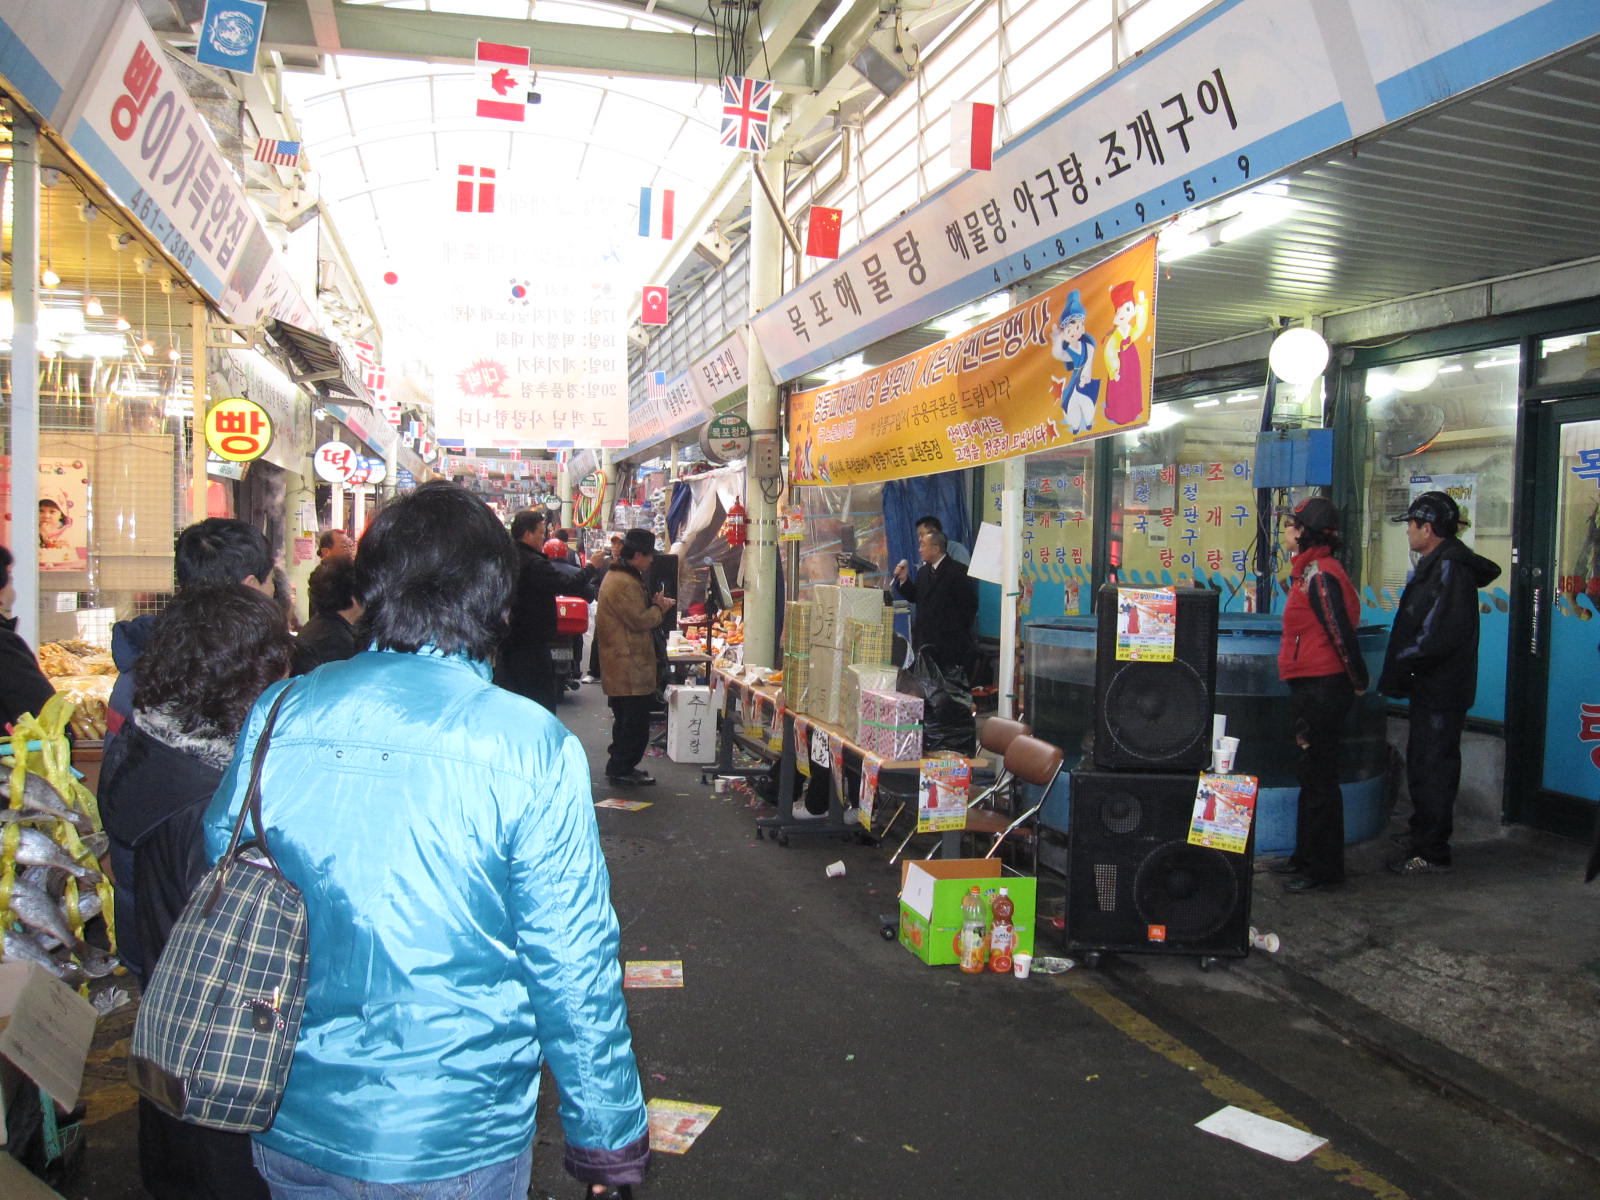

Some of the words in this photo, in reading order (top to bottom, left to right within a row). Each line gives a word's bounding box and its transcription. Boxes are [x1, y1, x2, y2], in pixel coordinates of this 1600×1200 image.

[109, 39, 249, 271] 빵이가득한집
[130, 187, 197, 269] 461-7386
[786, 229, 928, 344] 목포해물탕
[961, 375, 1012, 410] 드립니다
[215, 410, 266, 455] 빵
[321, 449, 352, 479] 떡
